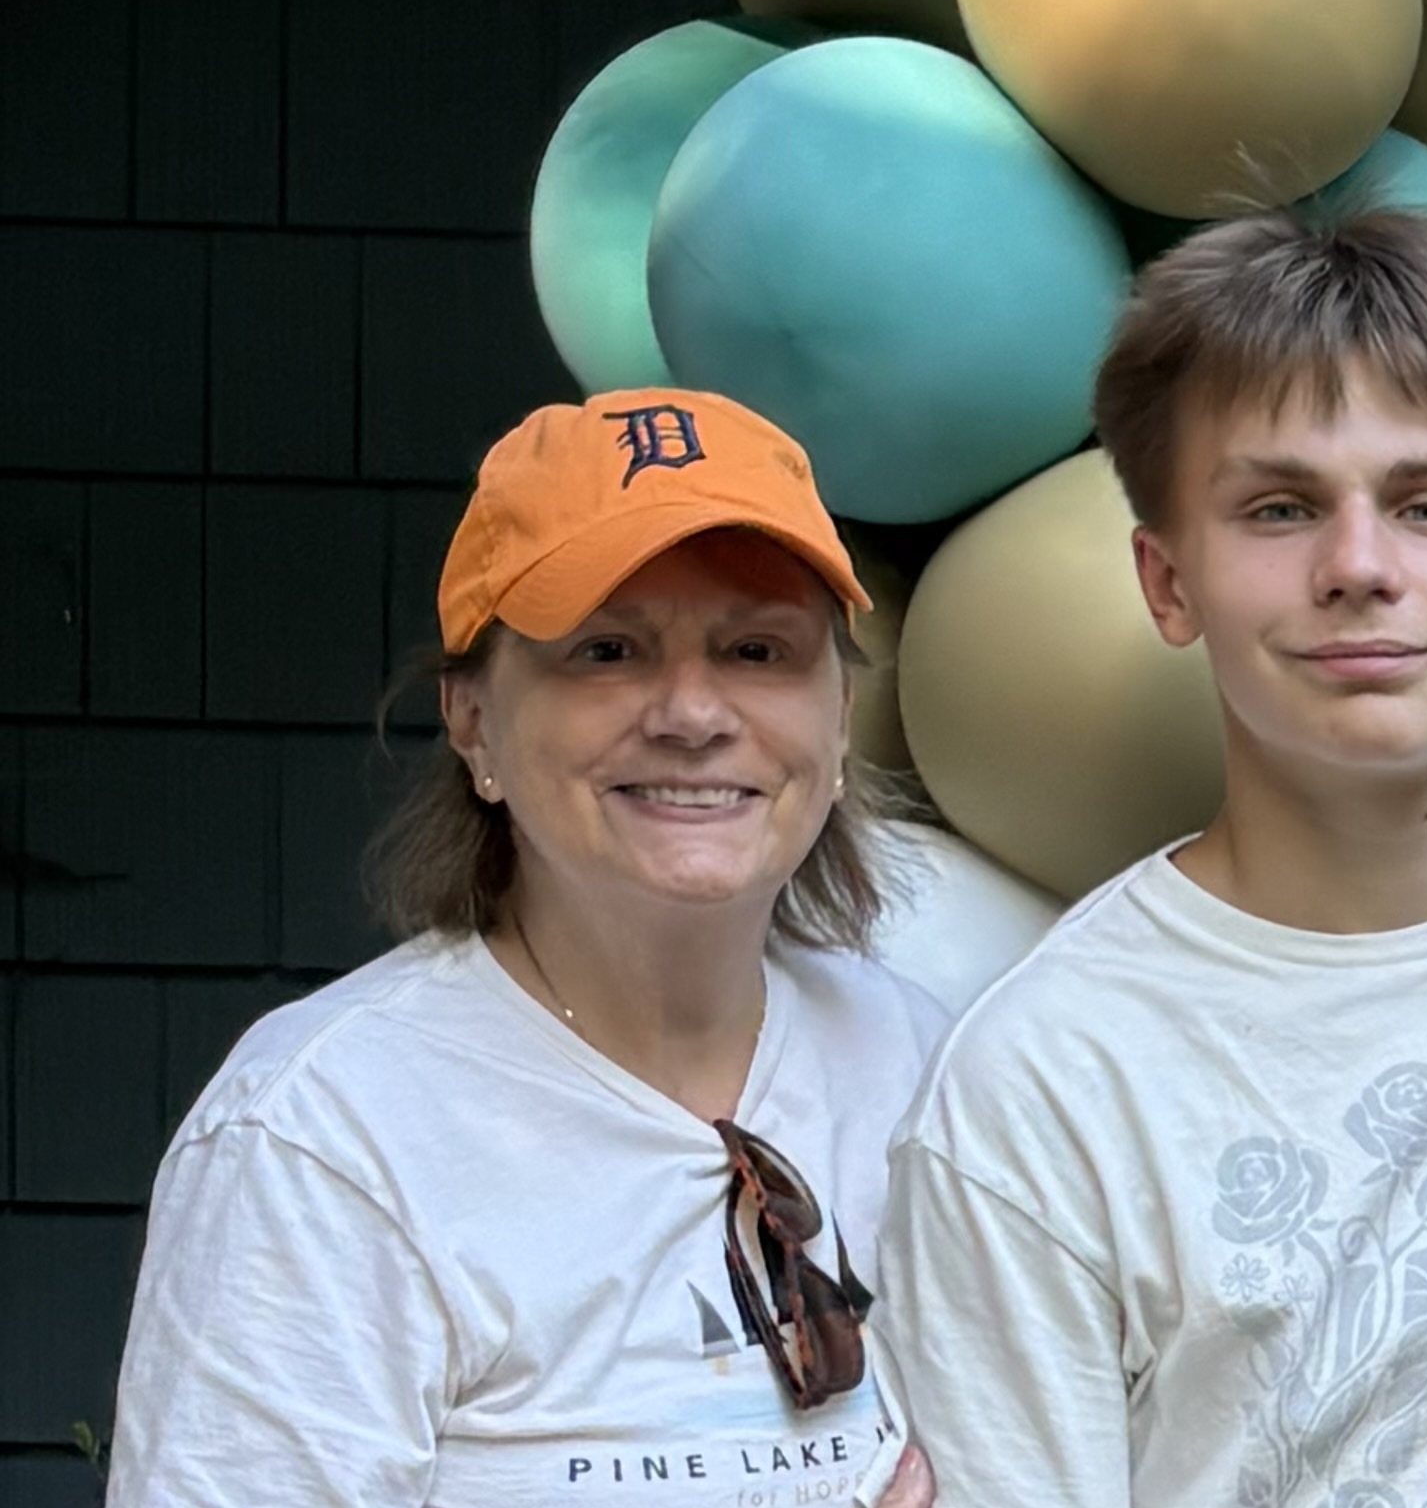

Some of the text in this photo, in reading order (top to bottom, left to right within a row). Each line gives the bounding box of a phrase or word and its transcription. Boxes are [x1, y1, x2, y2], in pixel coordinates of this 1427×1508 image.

[602, 404, 706, 490] D
[568, 1435, 849, 1483] PINE LAKE
